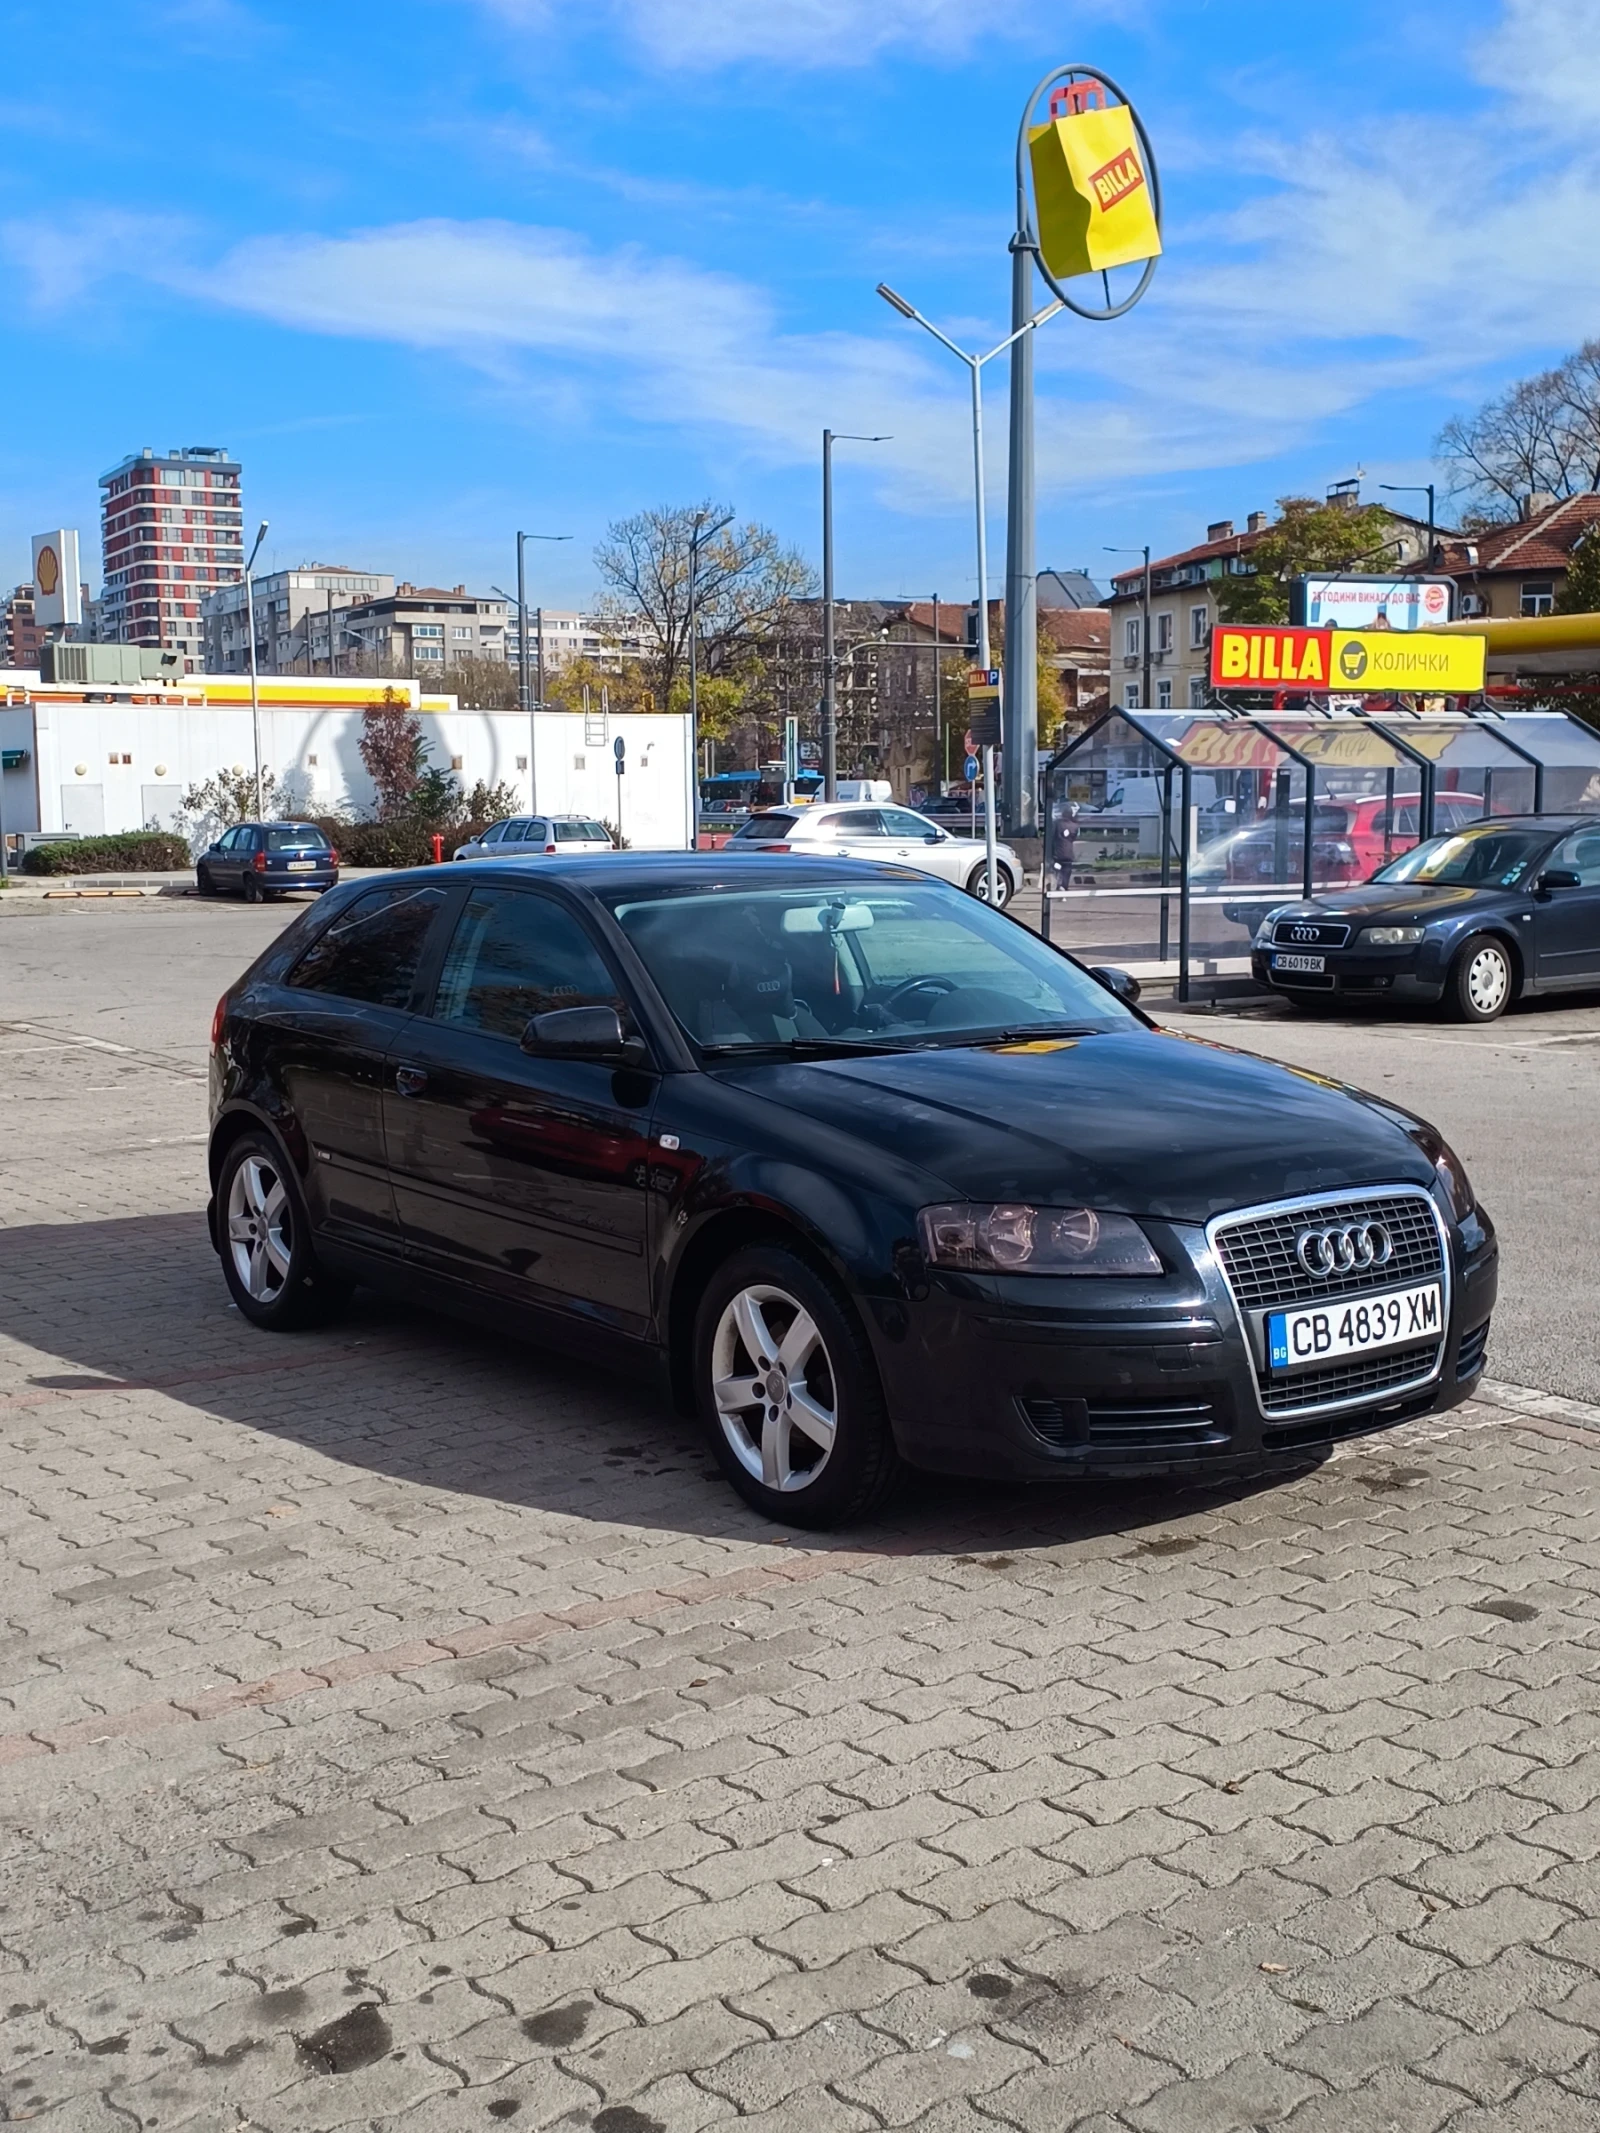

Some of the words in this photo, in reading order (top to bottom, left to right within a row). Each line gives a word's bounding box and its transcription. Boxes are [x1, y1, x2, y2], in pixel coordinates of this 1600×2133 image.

[1094, 157, 1140, 204] BILLA
[1322, 592, 1356, 604] ГОДИНИ
[1392, 593, 1404, 605] ДО
[1405, 593, 1421, 604] ВАС
[1221, 634, 1323, 680] BILLA
[1373, 652, 1449, 672] КОЛИЧКИ
[990, 671, 997, 684] P
[1277, 956, 1287, 968] CB
[1288, 957, 1309, 969] 6019
[1310, 958, 1322, 970] BK
[1293, 1314, 1332, 1356] CB
[1338, 1299, 1401, 1347] 4839
[1406, 1290, 1438, 1334] XM
[1273, 1346, 1287, 1360] BG
